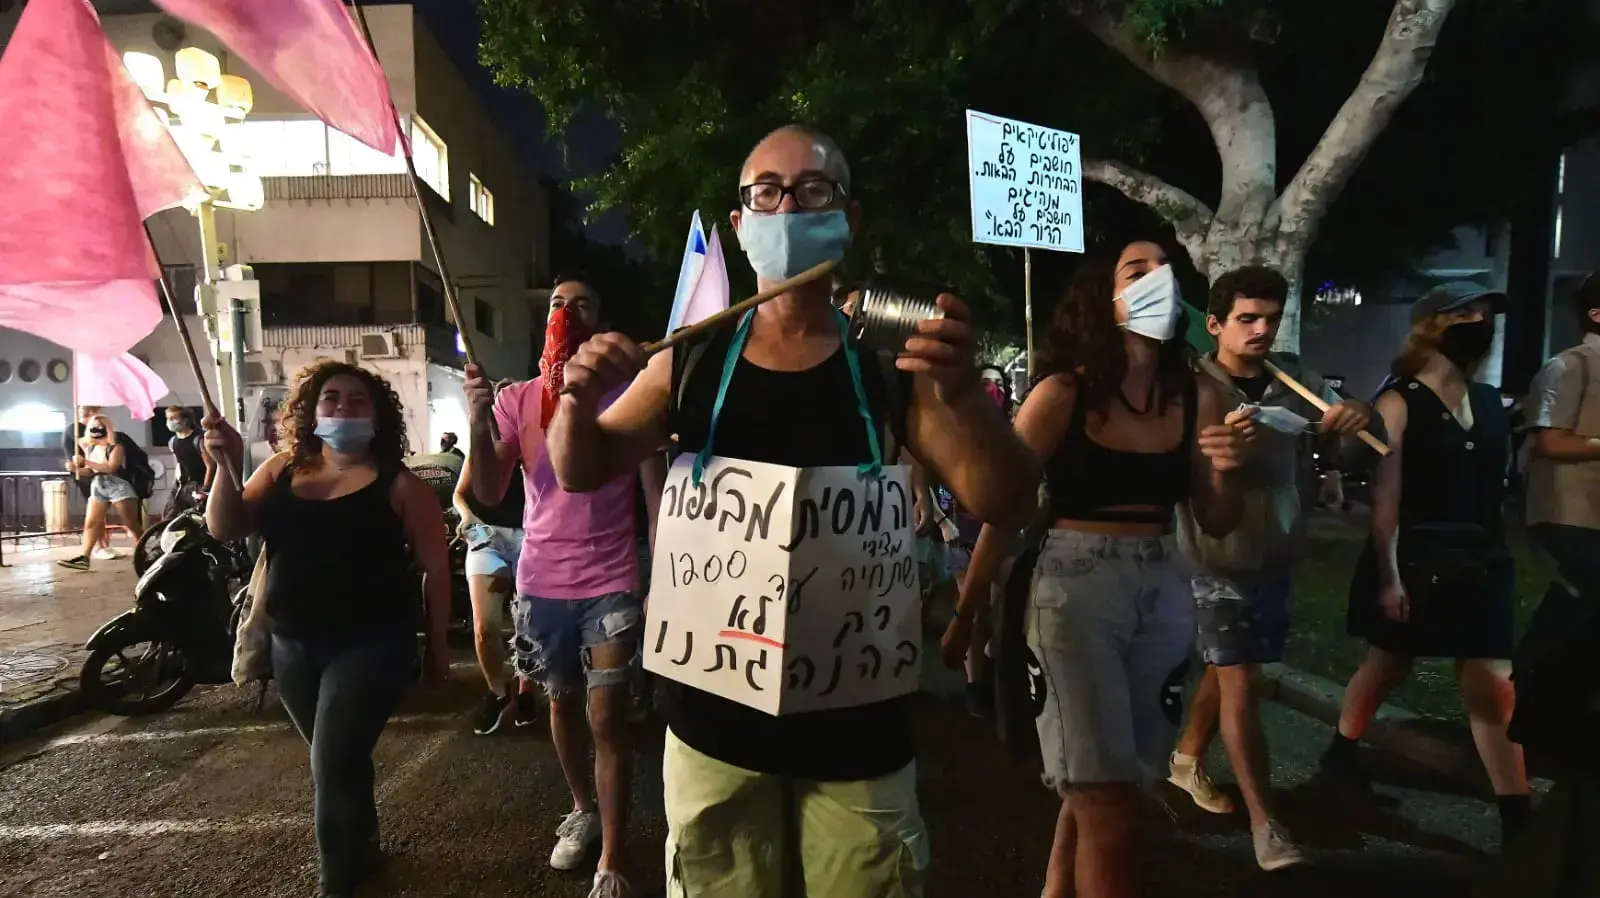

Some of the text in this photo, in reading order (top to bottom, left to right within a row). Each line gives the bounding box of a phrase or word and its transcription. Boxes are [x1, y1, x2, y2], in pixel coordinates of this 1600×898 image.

[998, 142, 1072, 175] חושבים על
[975, 161, 1077, 194] הבחירות הבאות.
[1008, 187, 1060, 211] מנהיגים
[1013, 202, 1071, 226] חושבים על
[1030, 223, 1062, 244] הדור
[664, 466, 907, 552] המסית מבלפור
[670, 550, 916, 614] שתחיה עד 1200
[727, 594, 891, 648] רק לא
